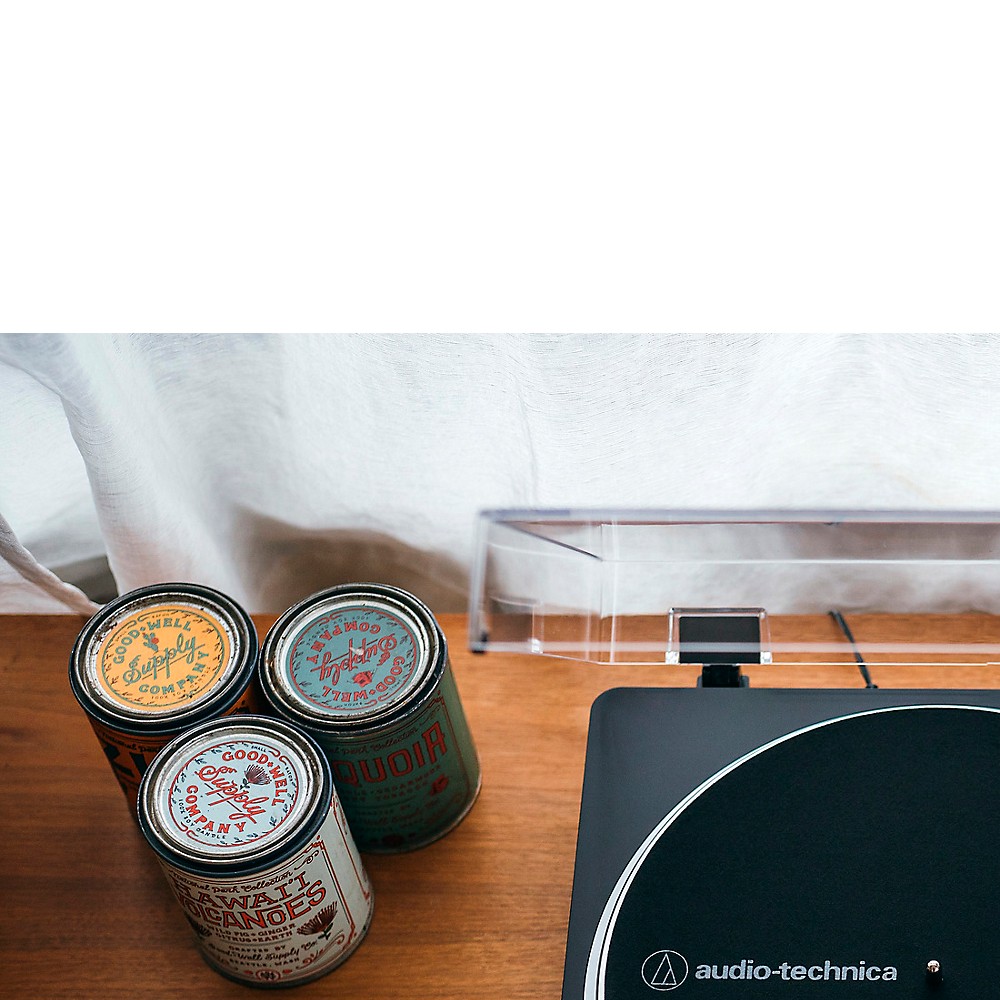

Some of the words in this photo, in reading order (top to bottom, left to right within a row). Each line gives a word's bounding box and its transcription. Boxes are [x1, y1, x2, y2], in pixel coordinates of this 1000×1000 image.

[122, 633, 206, 686] Supply
[306, 620, 381, 664] COMPANY
[310, 633, 397, 686] Supply
[139, 651, 210, 694] COMPANY
[222, 749, 268, 764] GOOD
[269, 765, 288, 806] WELL
[332, 720, 448, 788] QUOIA
[185, 785, 247, 833] COMPANY
[194, 765, 269, 824] Supply
[257, 923, 297, 937] GINGER
[695, 959, 898, 981] audio-technica
